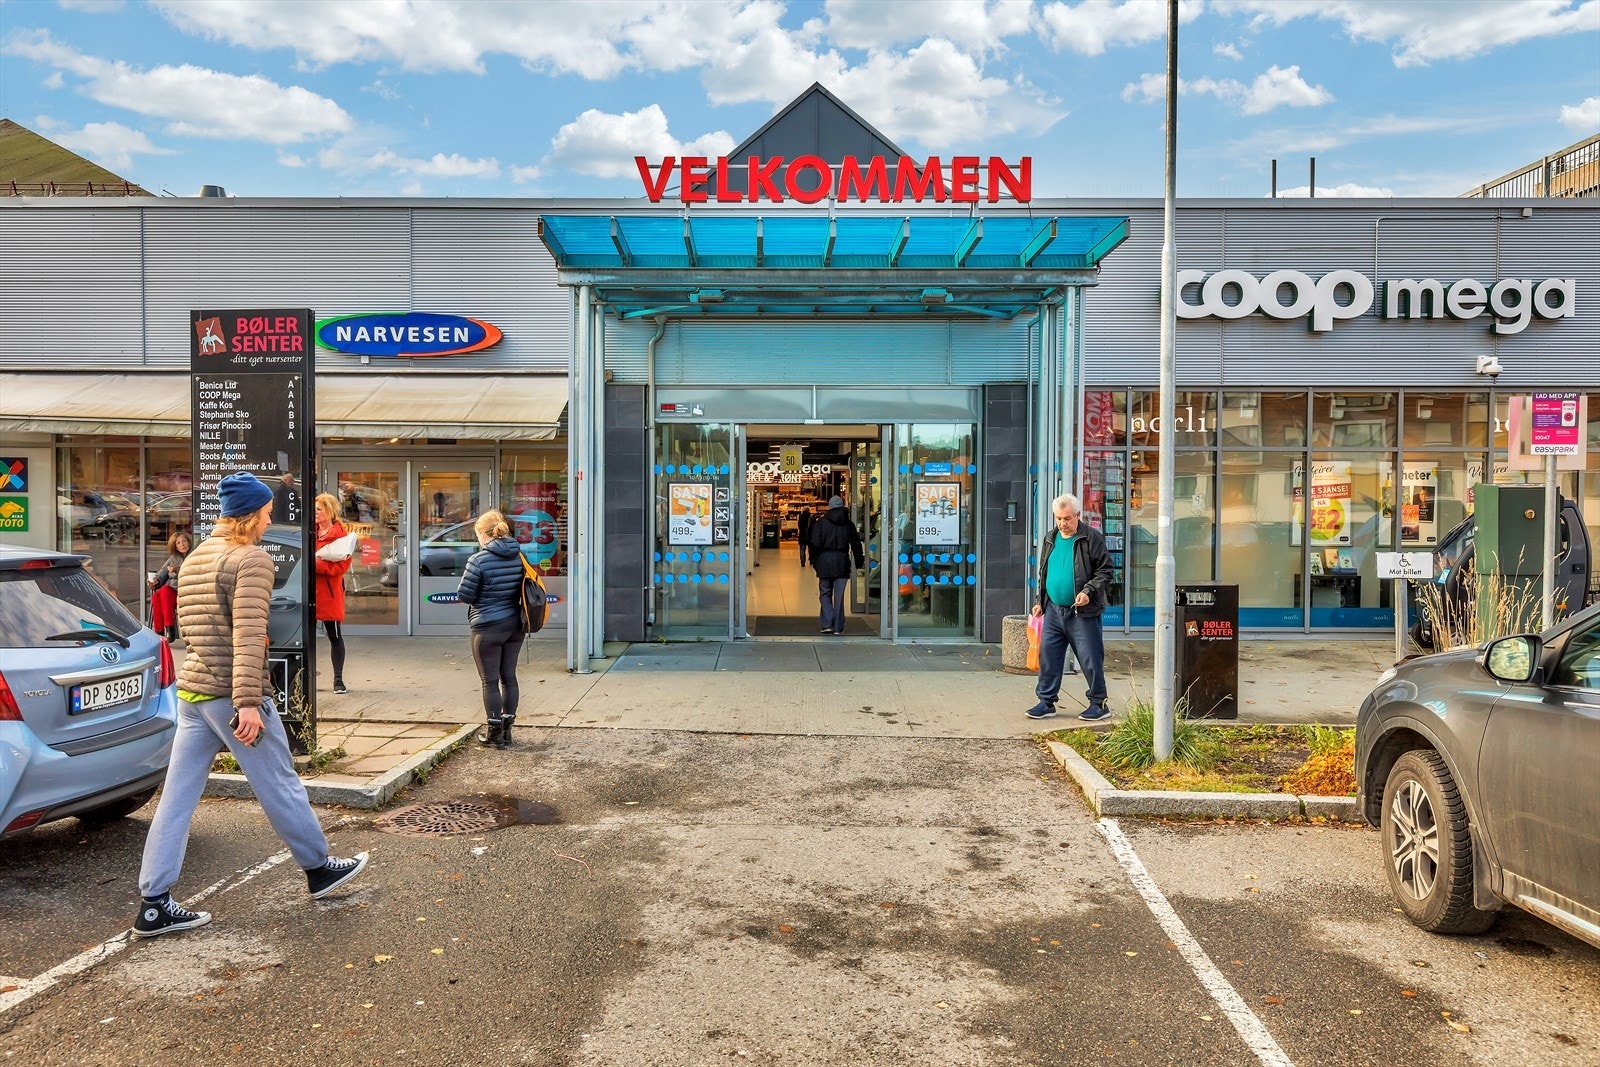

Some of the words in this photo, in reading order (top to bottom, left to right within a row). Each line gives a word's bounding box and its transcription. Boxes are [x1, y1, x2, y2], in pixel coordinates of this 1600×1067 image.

[634, 154, 1032, 204] VELKOMMEN
[1176, 269, 1374, 332] coop
[1383, 278, 1576, 334] mega
[237, 316, 298, 334] BØLER
[336, 326, 469, 343] NARVESEN
[231, 335, 303, 352] SENTER
[248, 356, 264, 366] eget
[200, 381, 223, 390] Benice
[225, 381, 237, 390] Ltd
[288, 380, 294, 388] A
[200, 391, 221, 399] COOP
[222, 391, 241, 400] Mega
[288, 391, 294, 399] A
[200, 401, 218, 409] Kaffe
[219, 401, 233, 409] Kos
[288, 401, 294, 409] A
[200, 411, 234, 420] Stephanie
[235, 410, 249, 418] Sko
[289, 411, 295, 419] B
[200, 421, 220, 430] Frisør
[221, 421, 252, 430] Pinoccio
[289, 421, 295, 429] B
[200, 432, 221, 440] NILLE
[288, 432, 294, 440] A
[200, 442, 223, 450] Mester
[224, 442, 247, 450] Grønn
[200, 452, 220, 460] Boots
[221, 452, 247, 461] Apotek
[786, 455, 795, 466] 50
[200, 462, 218, 471] Bøler
[220, 462, 260, 470] Brillesenter
[268, 462, 277, 470] Ur
[747, 461, 785, 477] oop
[672, 486, 709, 499] SALG
[919, 486, 956, 499] SALG
[1318, 485, 1349, 495] SJANSE!
[289, 492, 295, 500] C
[289, 502, 295, 510] C
[289, 512, 295, 520] D
[1326, 509, 1341, 530] 2
[516, 520, 555, 545] 33
[672, 526, 695, 536] 499,-
[918, 526, 942, 536] 699,-
[289, 554, 295, 562] A
[1203, 620, 1231, 629] BØLER
[1201, 628, 1233, 636] SENTER
[83, 687, 100, 707] DP
[105, 678, 139, 701] 85963
[278, 691, 286, 702] C
